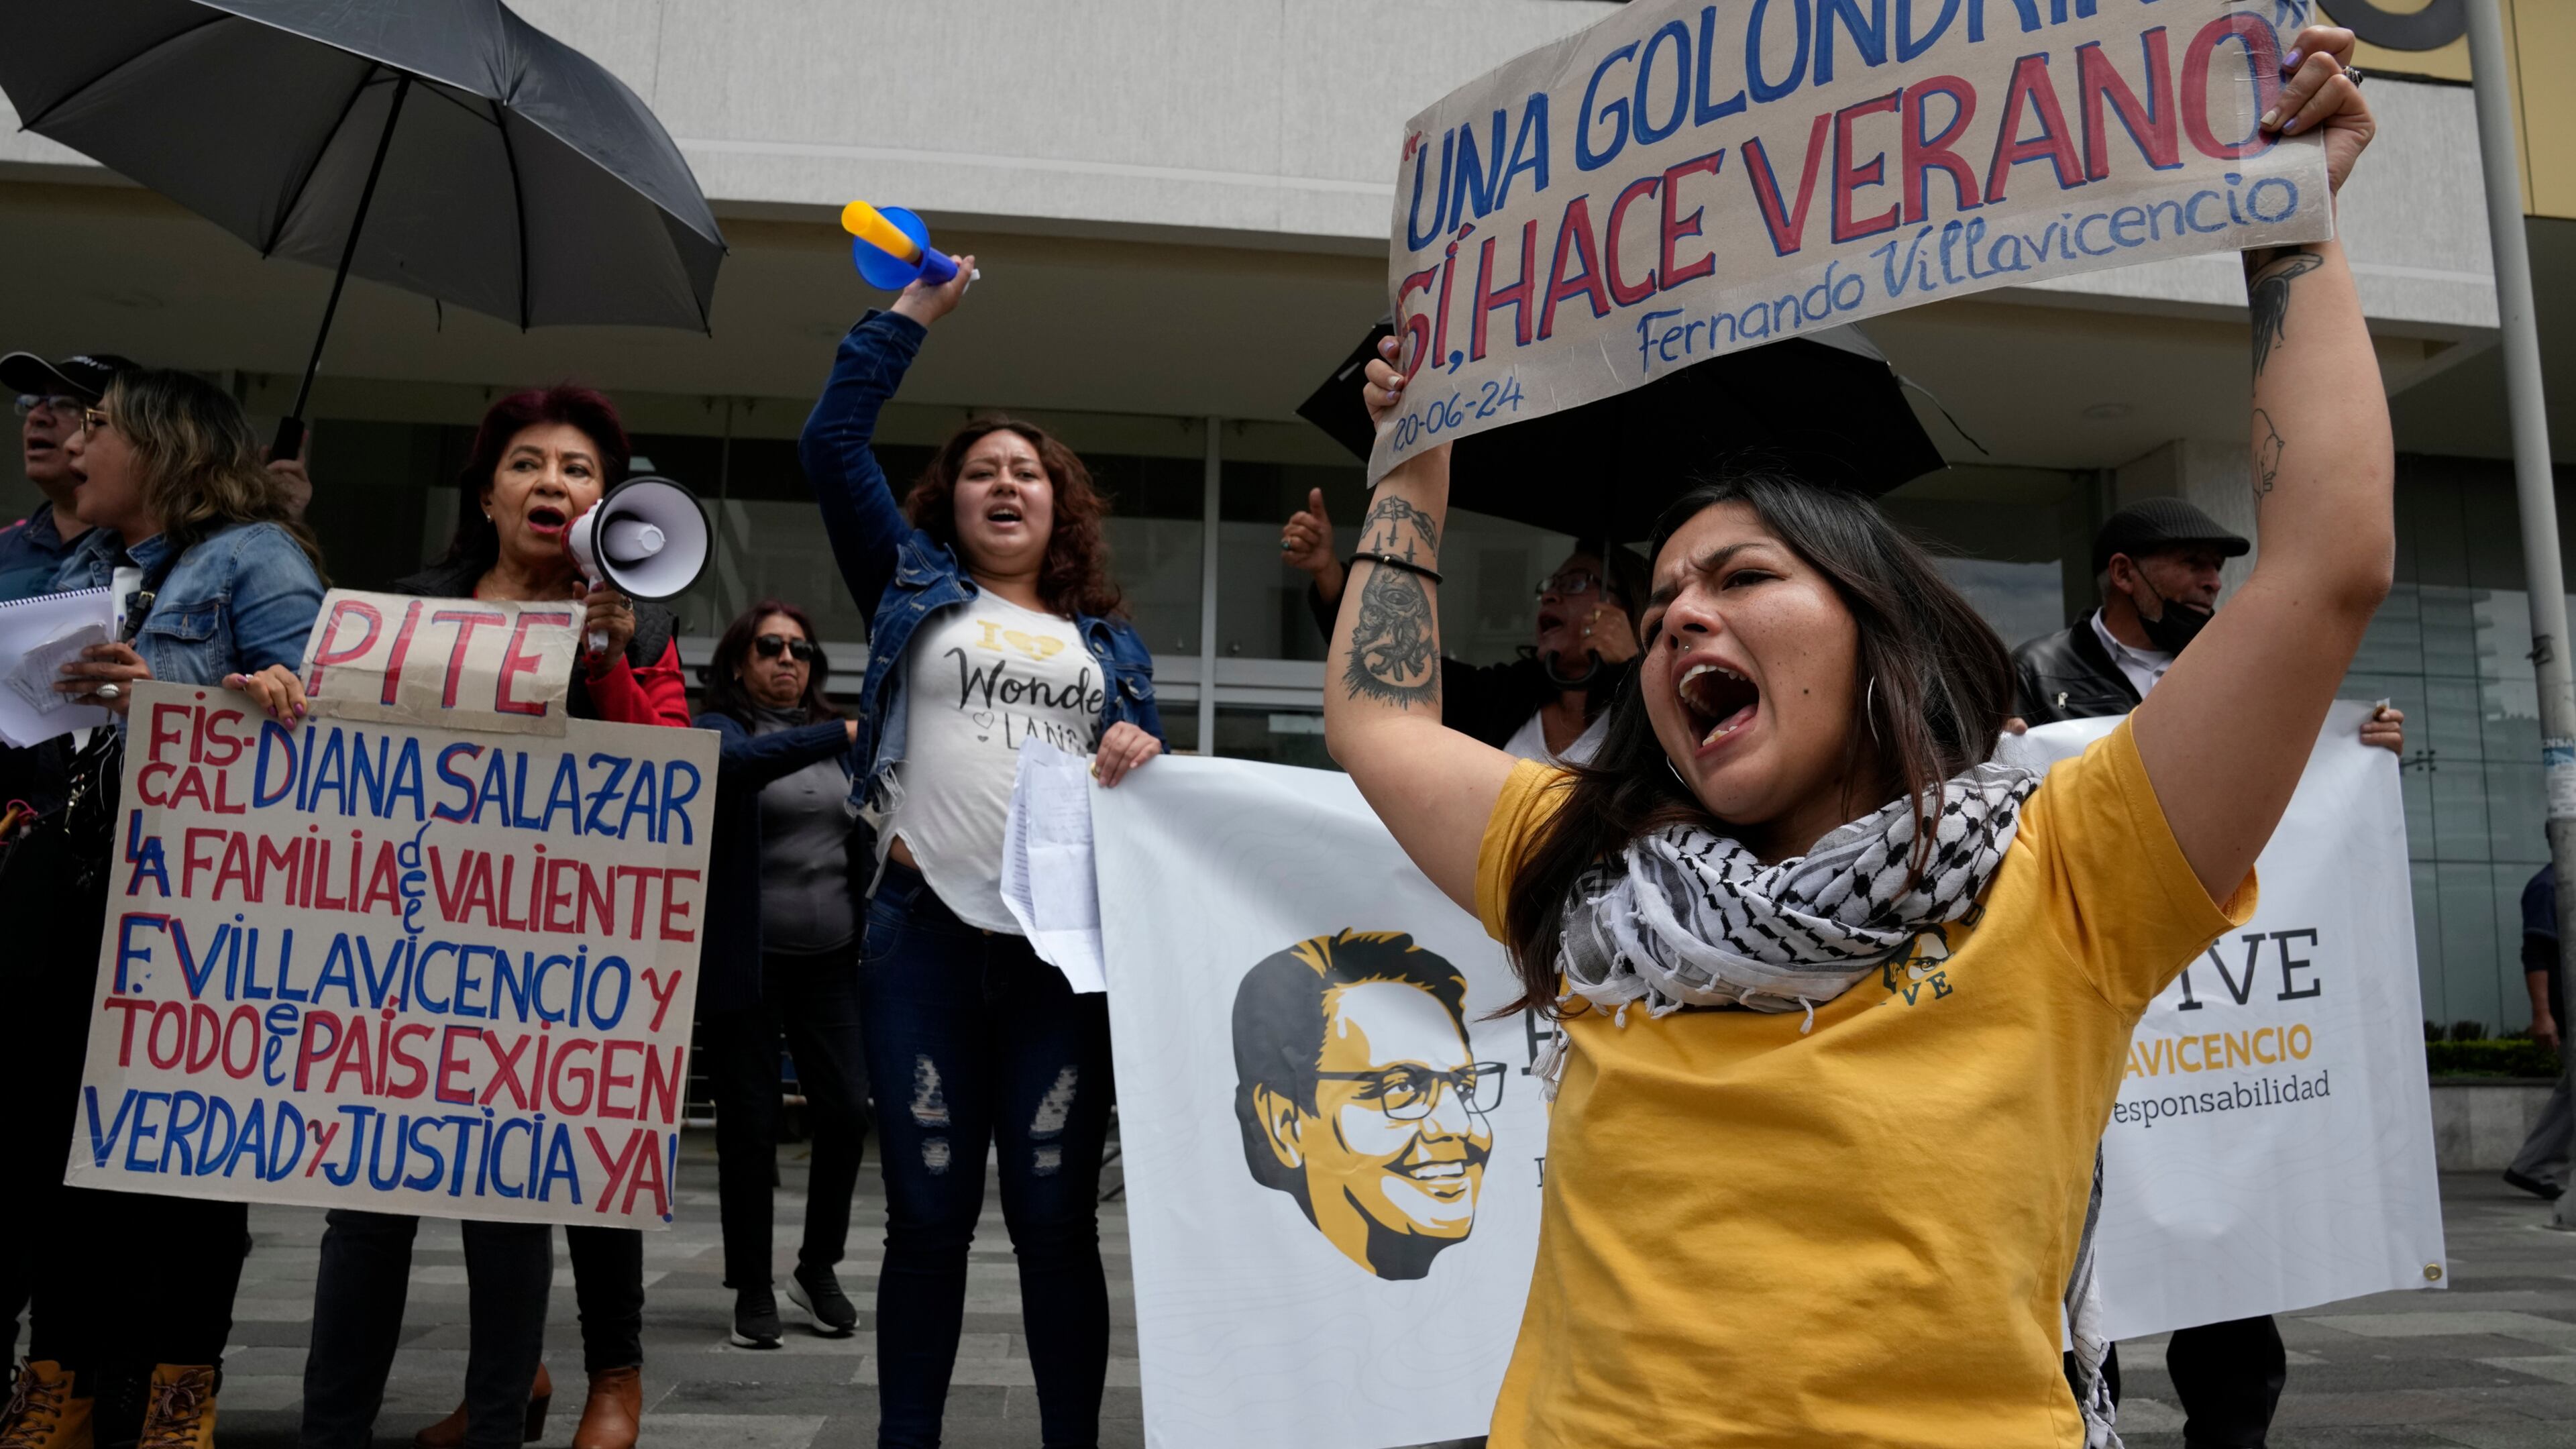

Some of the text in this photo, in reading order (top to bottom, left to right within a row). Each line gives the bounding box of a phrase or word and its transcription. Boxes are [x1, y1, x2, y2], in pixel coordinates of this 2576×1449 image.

[1638, 172, 2300, 374] Fernando Villavicencio
[1393, 376, 1525, 452] 20-06-24
[305, 598, 573, 717] PITE
[976, 619, 1003, 652] I
[137, 761, 246, 814] CAL
[148, 692, 256, 766] FIS-
[252, 715, 702, 845] DIANA SALAZAR
[125, 808, 172, 897] LA
[181, 824, 402, 916] FAMILIA
[427, 843, 701, 943] VALIENTE
[168, 913, 631, 1031] VILLAVICENCIO
[104, 996, 261, 1080] TODO
[293, 994, 436, 1100] PAÍS
[434, 1019, 684, 1124] EXIGEN
[83, 1085, 307, 1183] VERDAD
[320, 1104, 583, 1205] JUSTICIA
[583, 1126, 678, 1223] YA!
